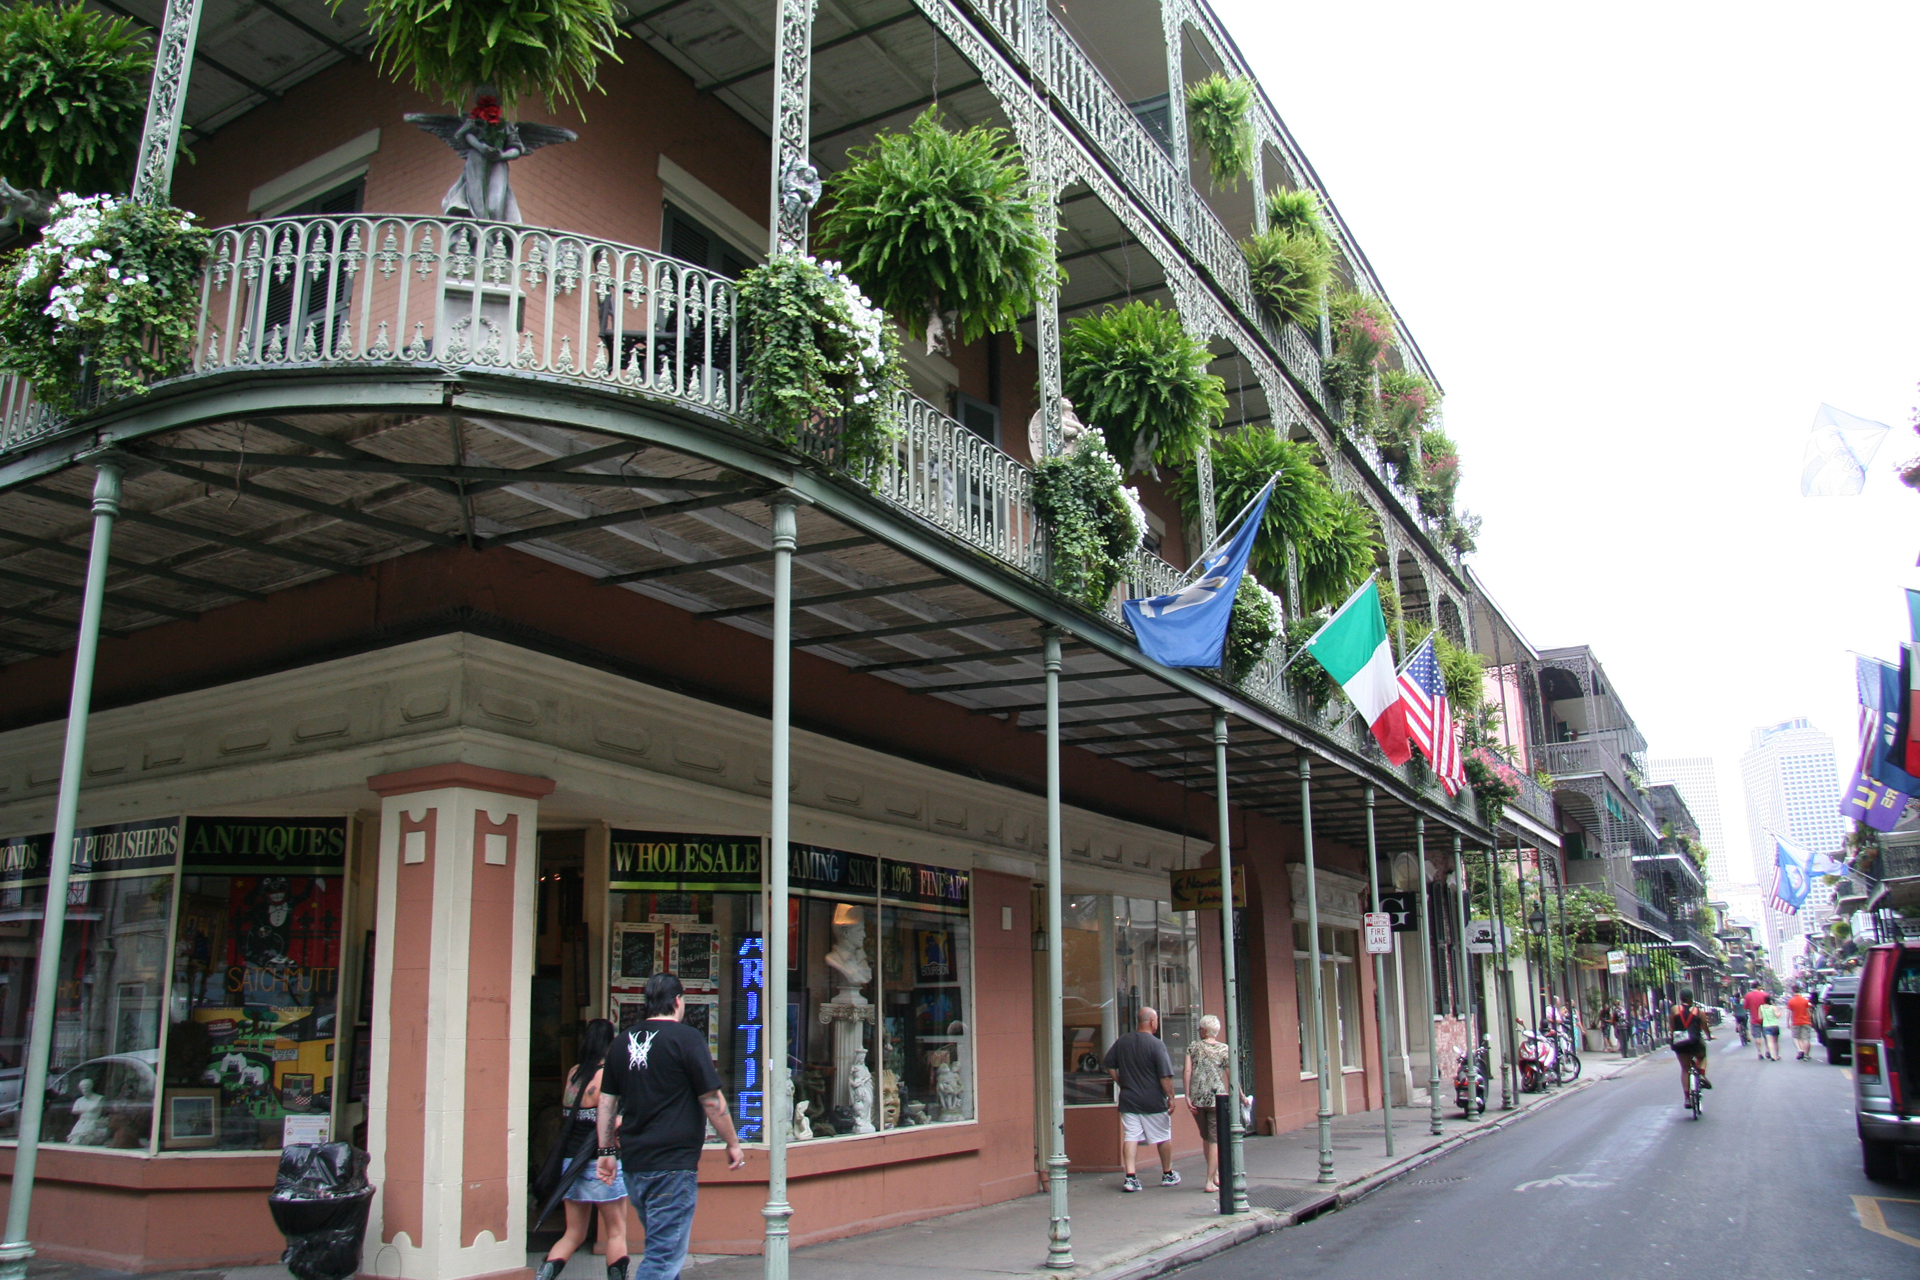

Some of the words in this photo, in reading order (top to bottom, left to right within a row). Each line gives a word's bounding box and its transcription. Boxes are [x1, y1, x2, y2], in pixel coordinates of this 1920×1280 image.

[82, 825, 178, 863] PUBLISHERS
[188, 824, 344, 861] ANTIQUES
[613, 842, 760, 873] WHOLESALE
[788, 849, 839, 882] AMING
[848, 858, 888, 890] SINCE
[891, 865, 912, 893] 1976
[919, 869, 946, 898] FINE
[947, 875, 969, 900] ART
[1379, 898, 1410, 926] G
[1370, 927, 1386, 936] FIRE
[1370, 936, 1387, 945] LANE
[227, 967, 336, 992] SATCHMUTT
[921, 965, 950, 976] BOURBON
